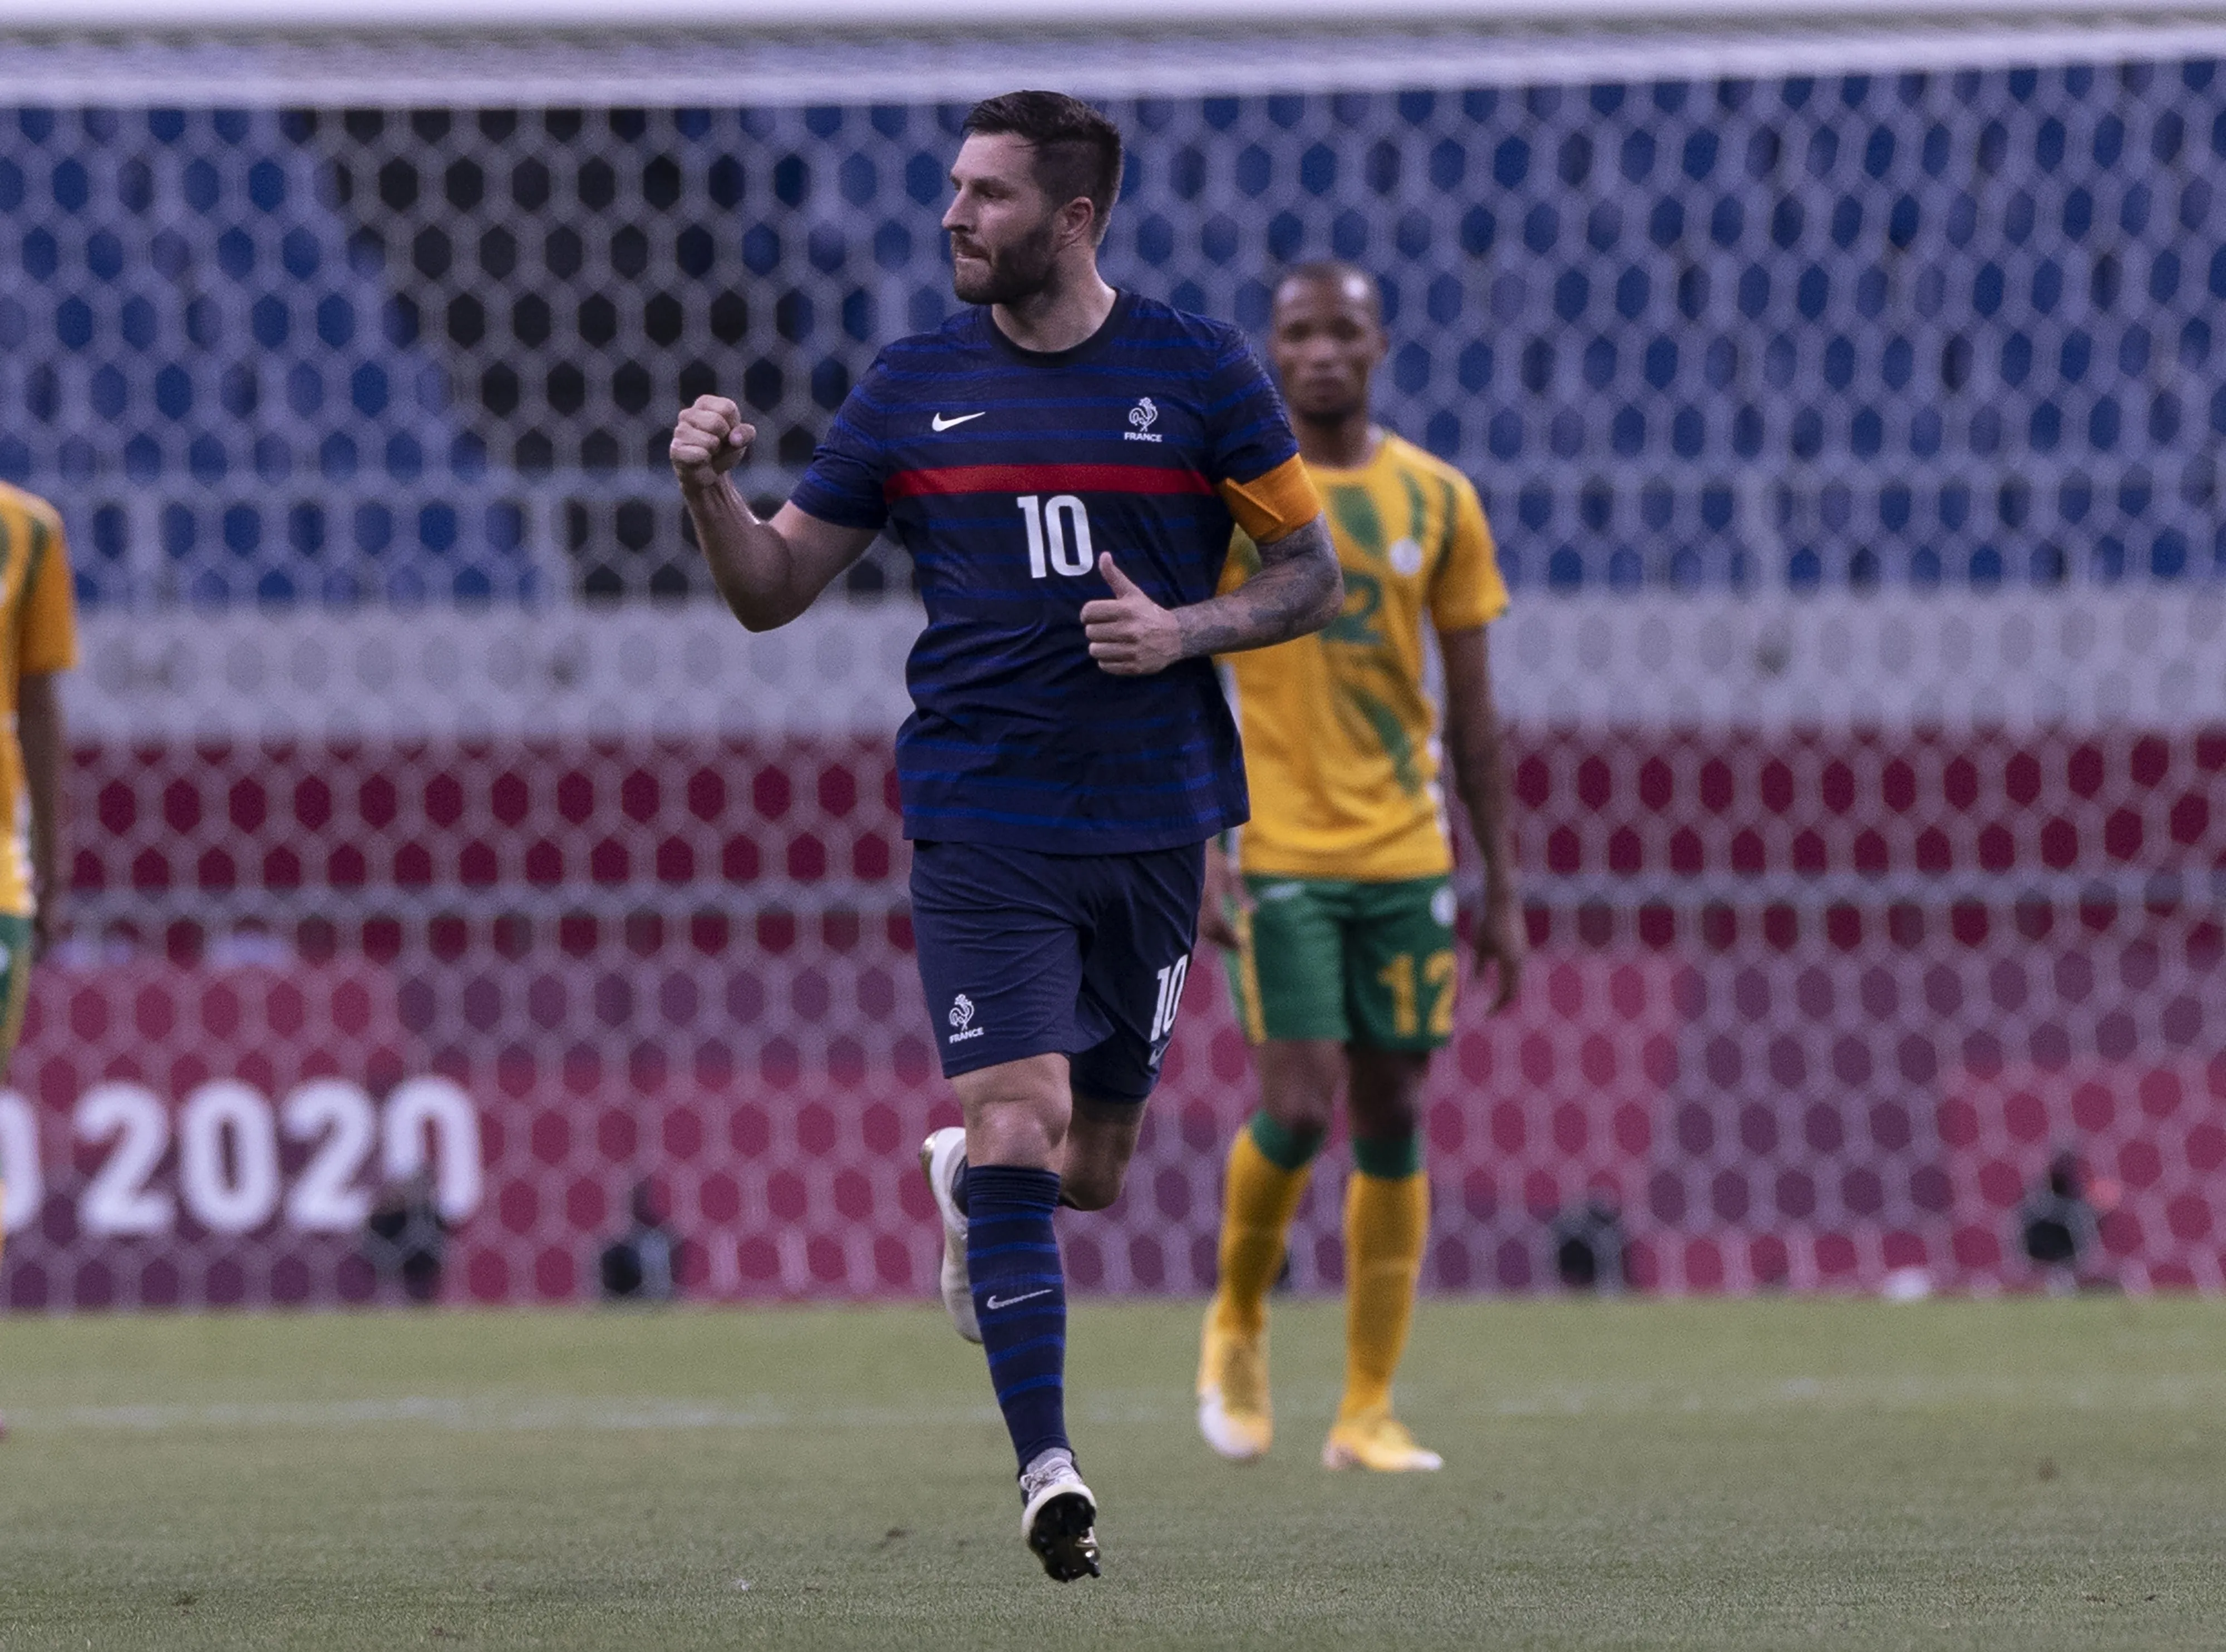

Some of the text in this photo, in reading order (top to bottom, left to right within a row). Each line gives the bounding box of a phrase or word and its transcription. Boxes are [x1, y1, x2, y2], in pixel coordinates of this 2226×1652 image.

[1124, 432, 1163, 442] FRANCE
[1017, 495, 1094, 579] 10
[1319, 569, 1387, 647] 2
[949, 1027, 984, 1044] FRANCE
[1150, 954, 1188, 1043] 10
[1377, 949, 1457, 1038] 12
[75, 1078, 483, 1232] 2020
